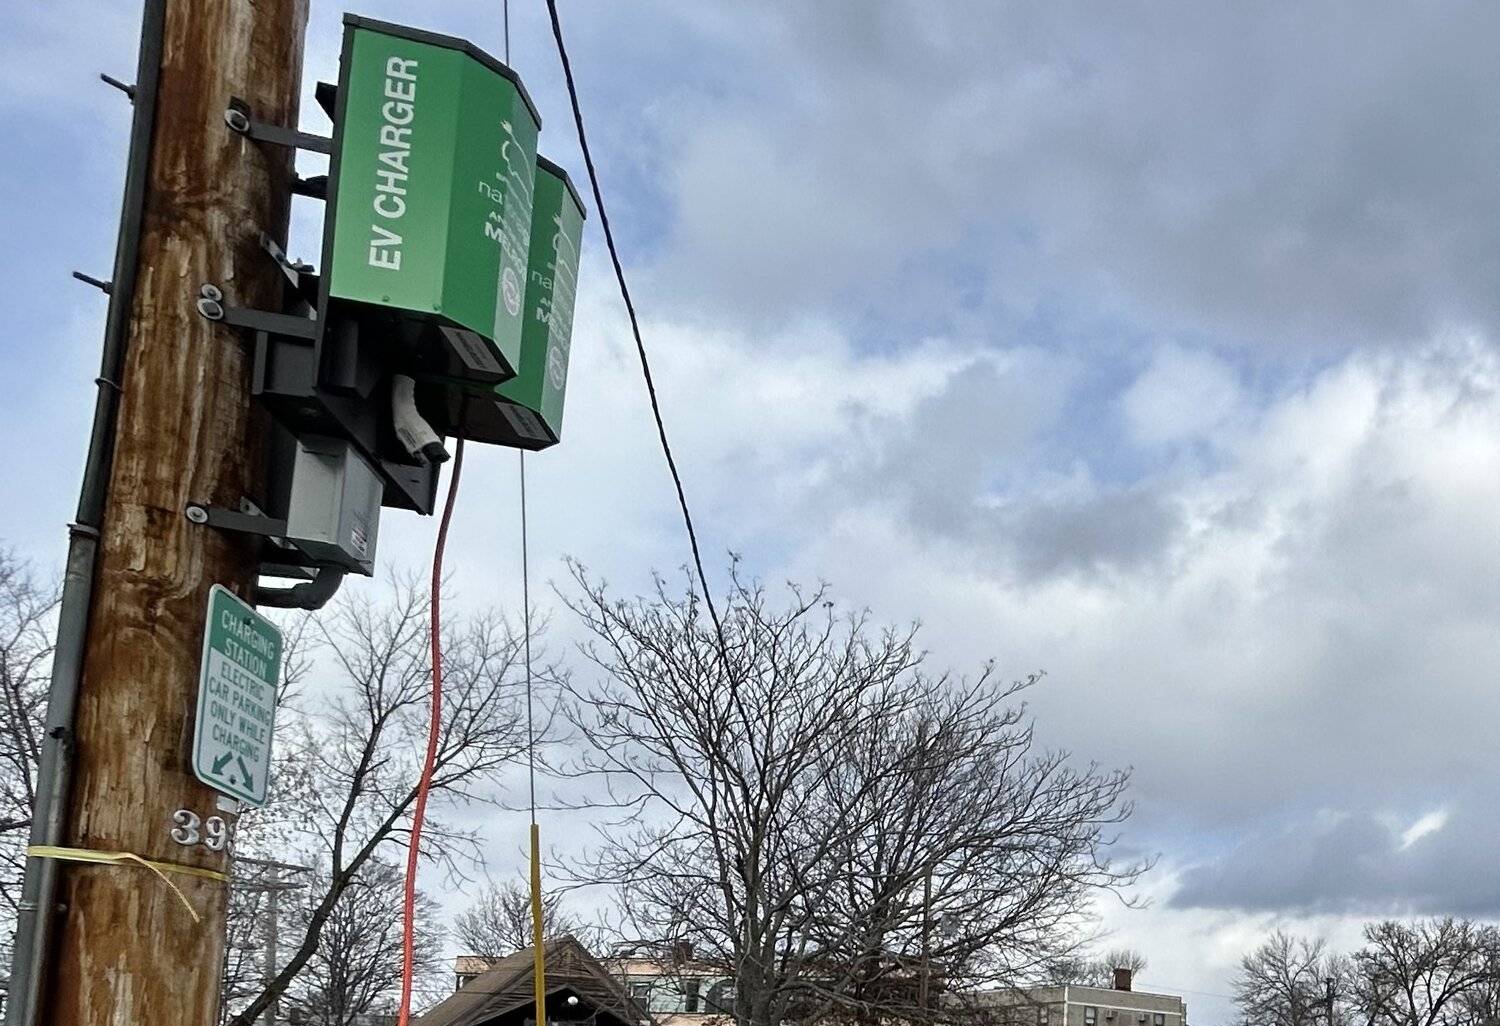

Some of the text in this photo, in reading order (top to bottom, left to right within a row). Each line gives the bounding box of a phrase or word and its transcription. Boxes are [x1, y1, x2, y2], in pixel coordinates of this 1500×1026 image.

[368, 56, 418, 271] EV CHARGER
[221, 610, 275, 660] CHARGING
[224, 637, 267, 680] STATION
[209, 676, 271, 727] CAR PARKING
[221, 661, 265, 702] ELECTRIC
[210, 700, 266, 745] ONLY WHILE
[212, 723, 260, 763] CHARGING
